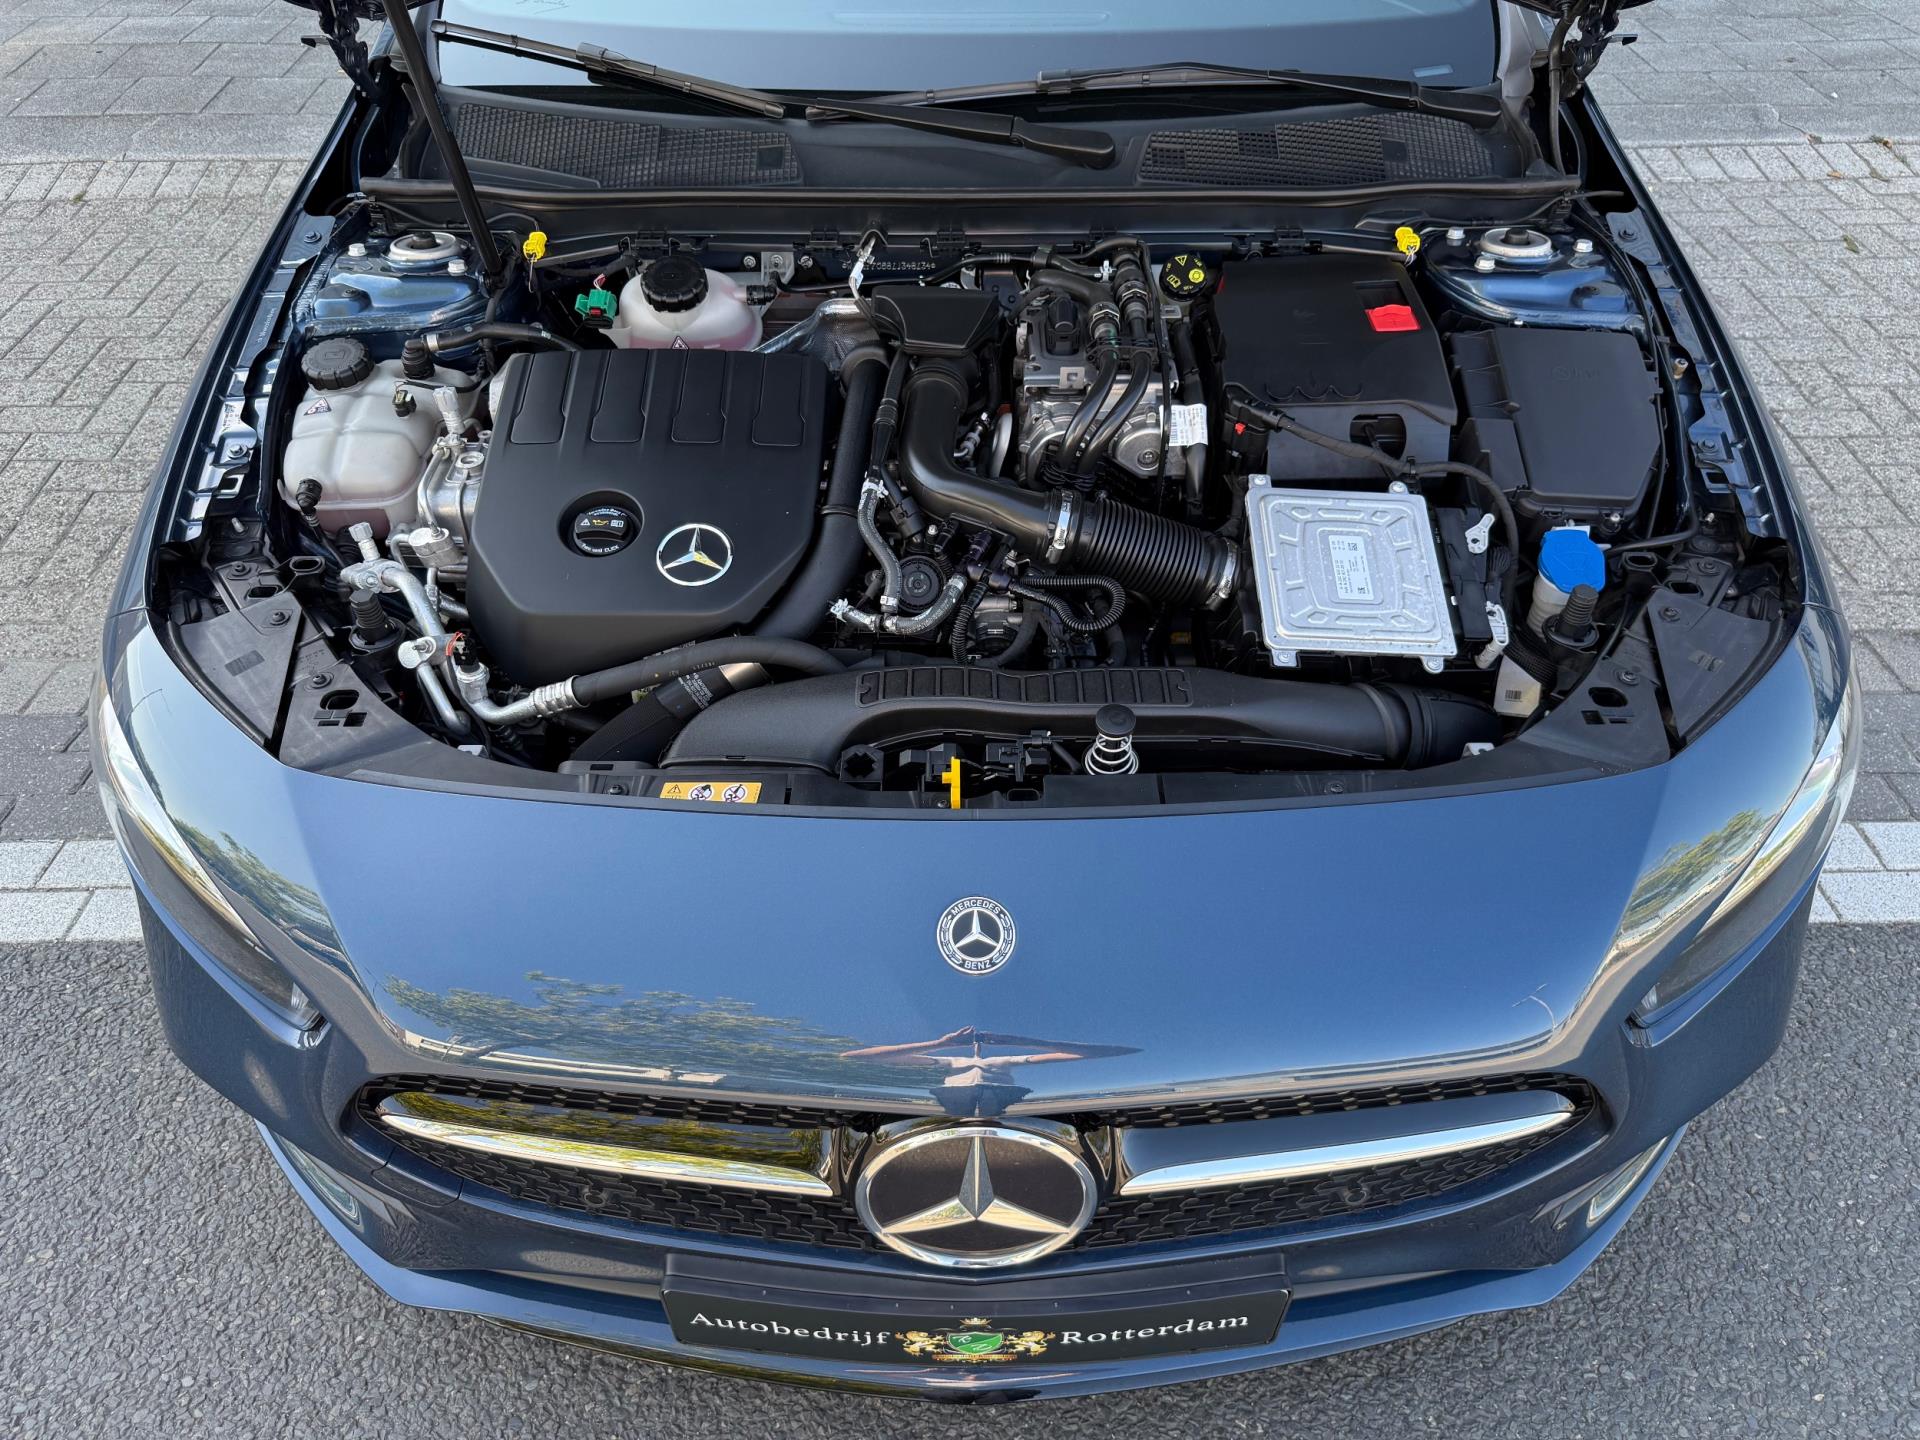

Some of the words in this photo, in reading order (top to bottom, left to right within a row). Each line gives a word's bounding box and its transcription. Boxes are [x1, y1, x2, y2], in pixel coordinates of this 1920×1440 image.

[950, 899, 1001, 916] MERCEDES
[964, 959, 992, 970] BENZ
[689, 1312, 891, 1347] Autobedrijf
[1059, 1315, 1249, 1345] Rotterdam
